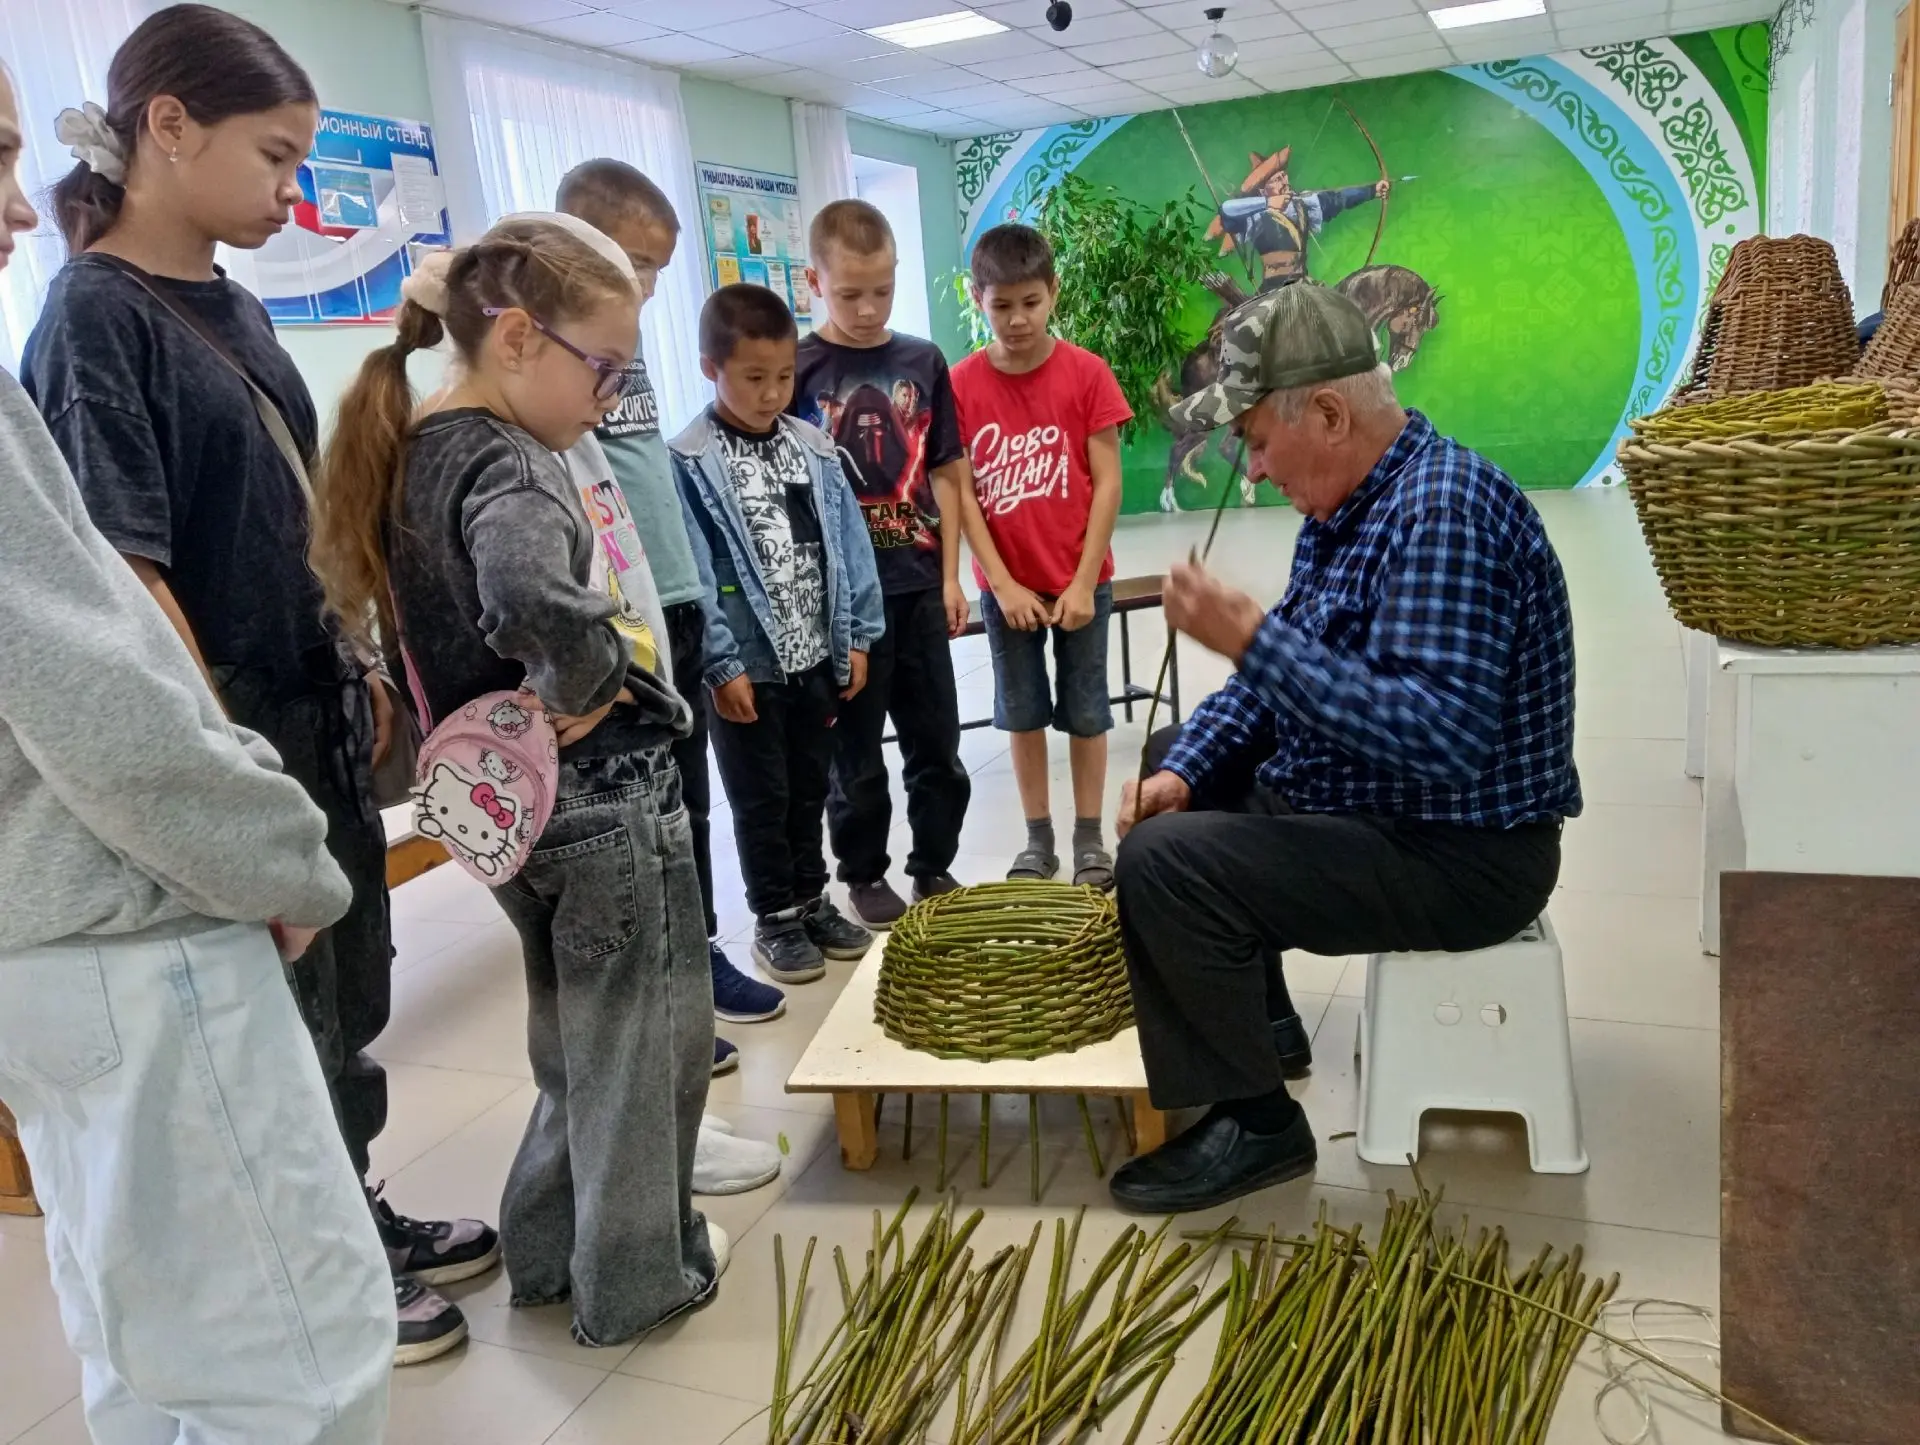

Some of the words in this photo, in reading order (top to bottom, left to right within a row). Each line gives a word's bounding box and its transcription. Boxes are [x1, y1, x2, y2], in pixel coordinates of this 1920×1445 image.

[316, 116, 382, 141] ИОННЫЙ
[386, 125, 430, 149] СТЕНД
[755, 177, 775, 192] НАШИ
[775, 181, 797, 195] УСПЕХИ
[858, 501, 917, 523] TAR
[868, 526, 920, 548] ARS
